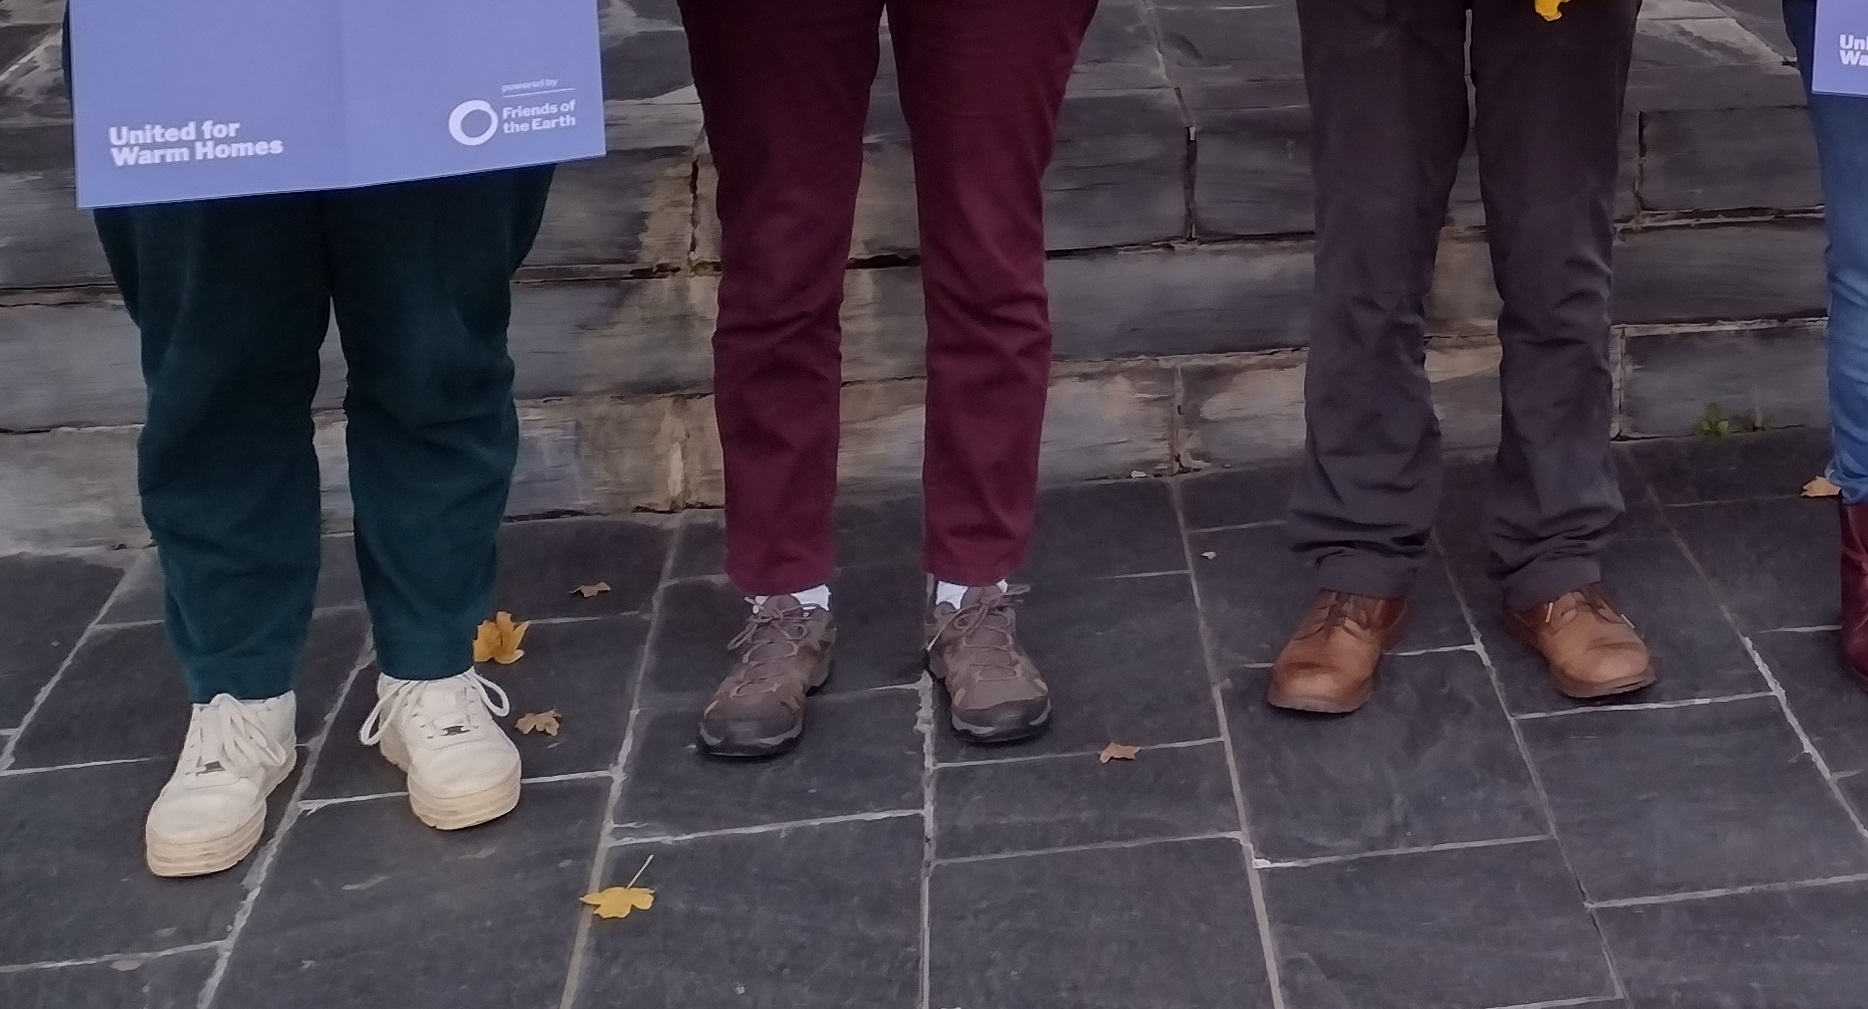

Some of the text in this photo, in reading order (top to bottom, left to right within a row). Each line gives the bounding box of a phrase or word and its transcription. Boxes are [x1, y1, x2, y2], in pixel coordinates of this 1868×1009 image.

[501, 78, 558, 92] powered by
[502, 99, 576, 119] Friends of
[109, 120, 241, 145] United for
[503, 115, 576, 133] the Earth
[110, 140, 284, 166] Warm Homes
